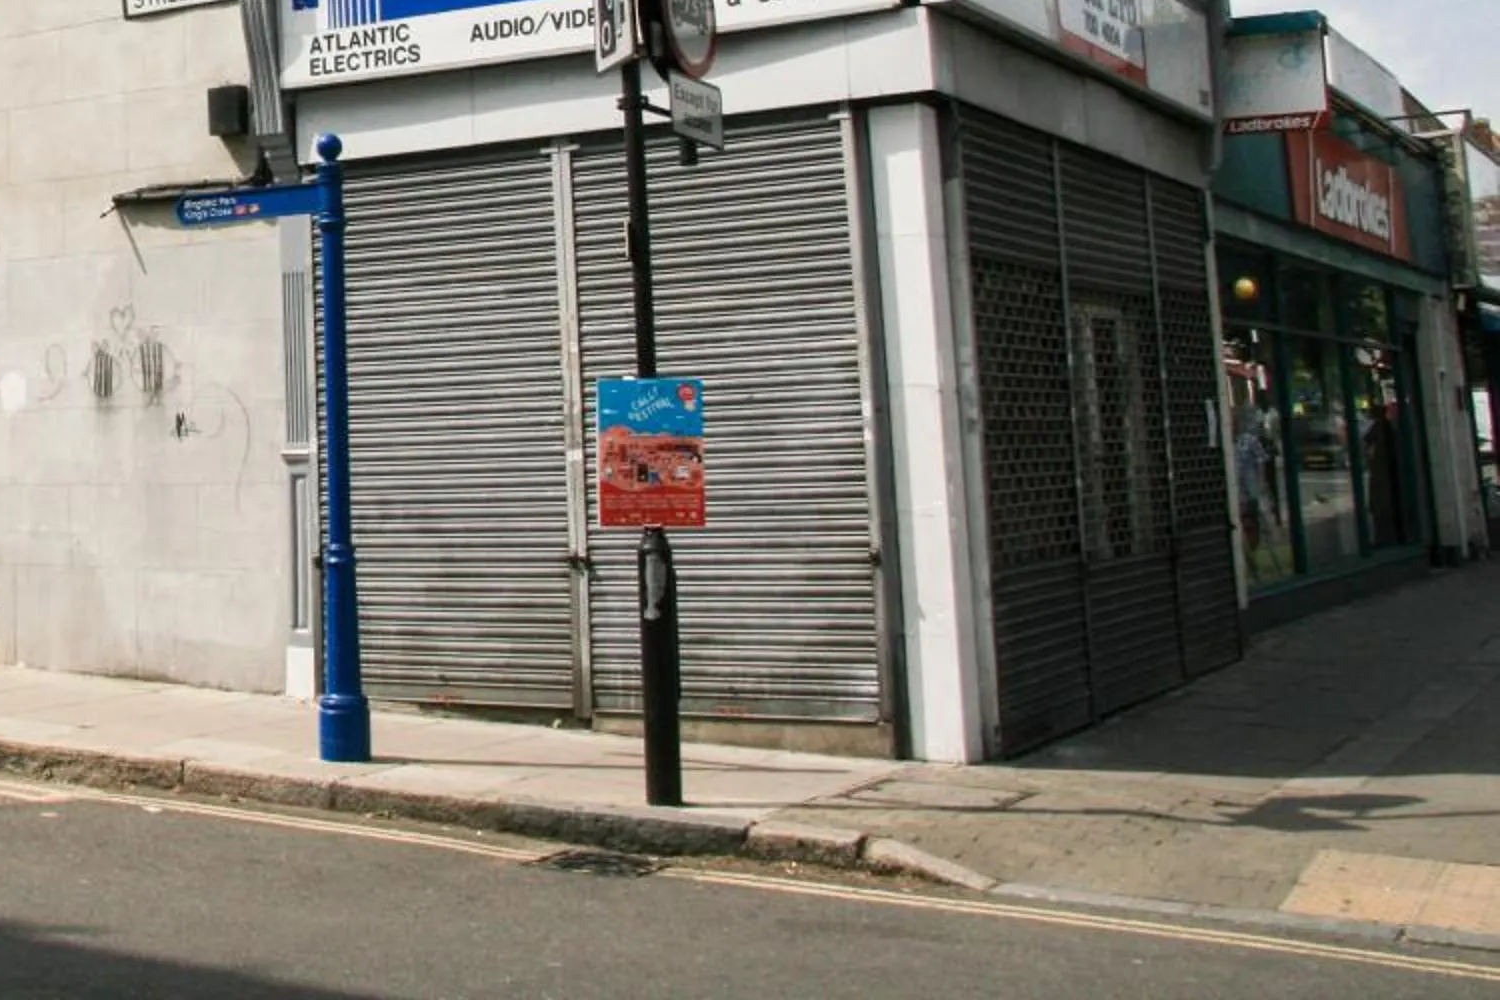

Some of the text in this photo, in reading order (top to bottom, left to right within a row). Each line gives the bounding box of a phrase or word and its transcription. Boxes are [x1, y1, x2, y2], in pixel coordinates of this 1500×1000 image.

[309, 22, 411, 55] ATLANTIC
[469, 8, 596, 43] AUDIO/VIDE
[309, 44, 421, 77] ELECTRICS
[1227, 114, 1312, 134] Ladbrokes
[1315, 157, 1390, 242] Ladbrokes
